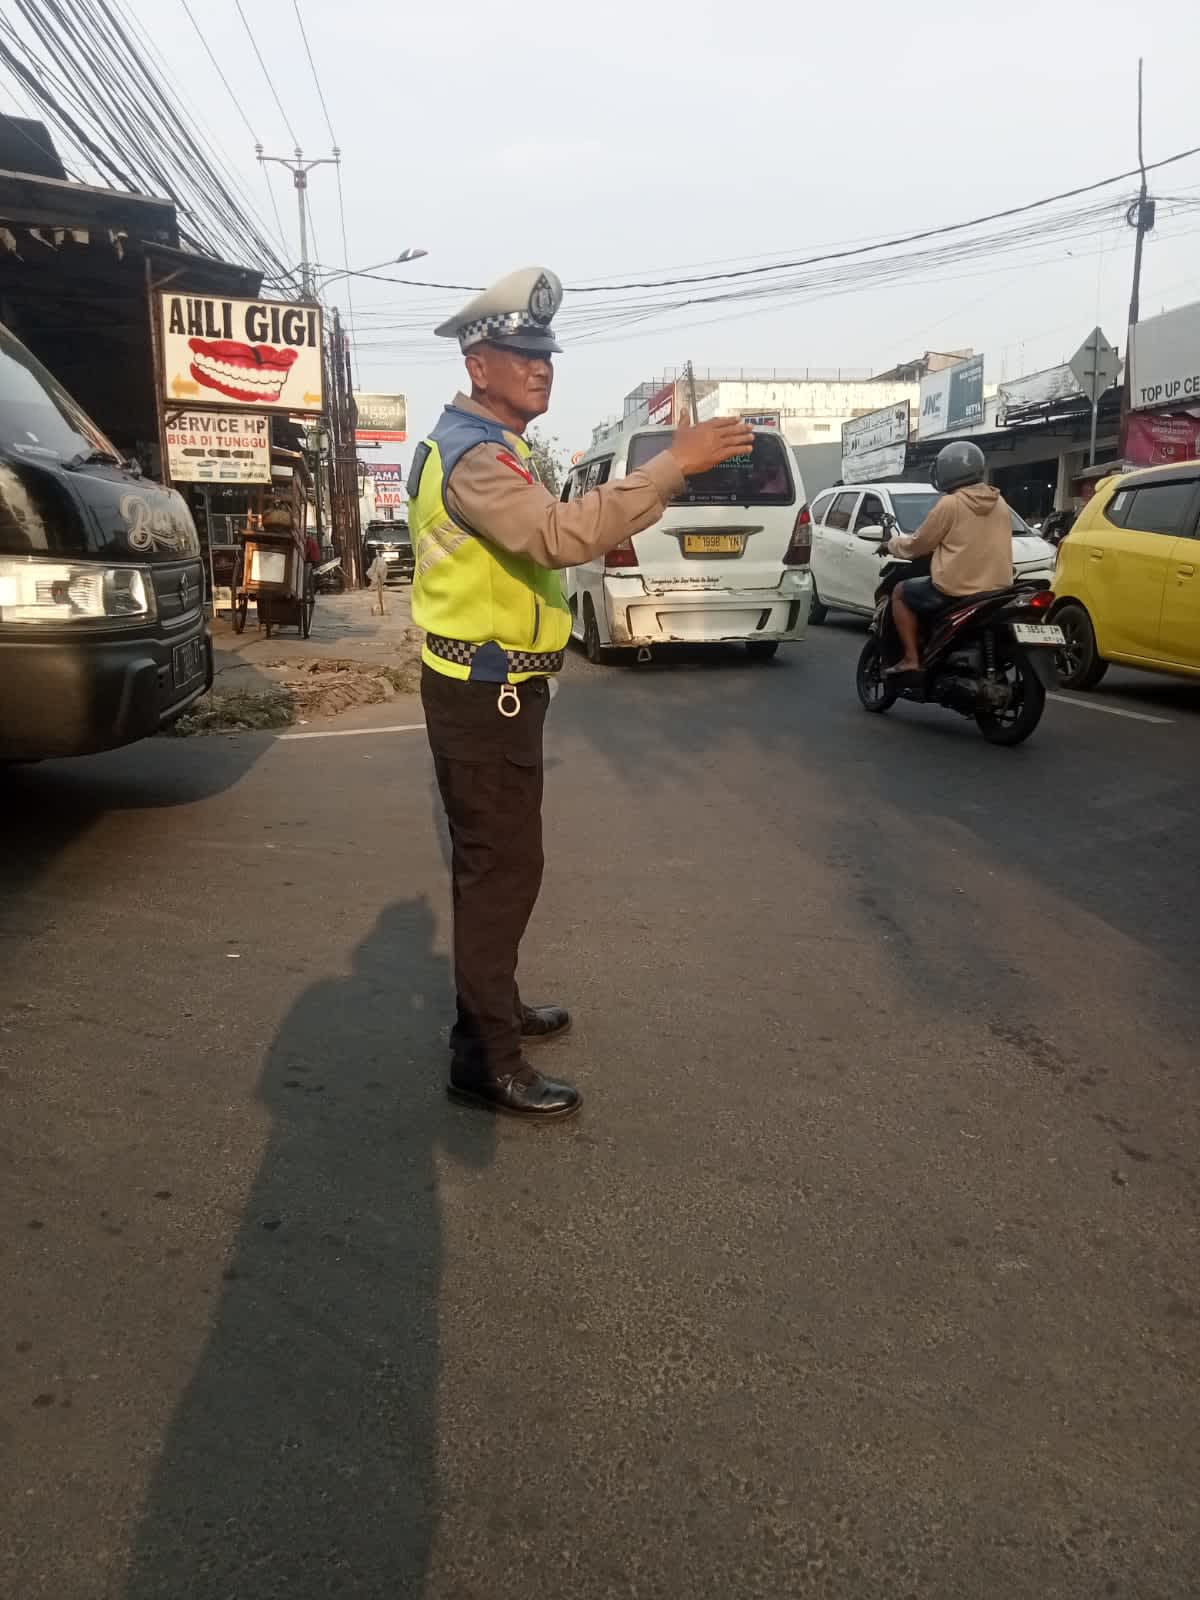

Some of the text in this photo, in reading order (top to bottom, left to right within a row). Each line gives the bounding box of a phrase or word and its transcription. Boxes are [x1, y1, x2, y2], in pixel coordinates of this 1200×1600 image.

[169, 297, 317, 347] AHLI GIGI
[1140, 384, 1162, 403] TOP
[1165, 380, 1181, 398] UP
[166, 415, 266, 434] SERVICE HP
[167, 434, 266, 448] BISA DI TUNGGU
[702, 536, 721, 547] 1998
